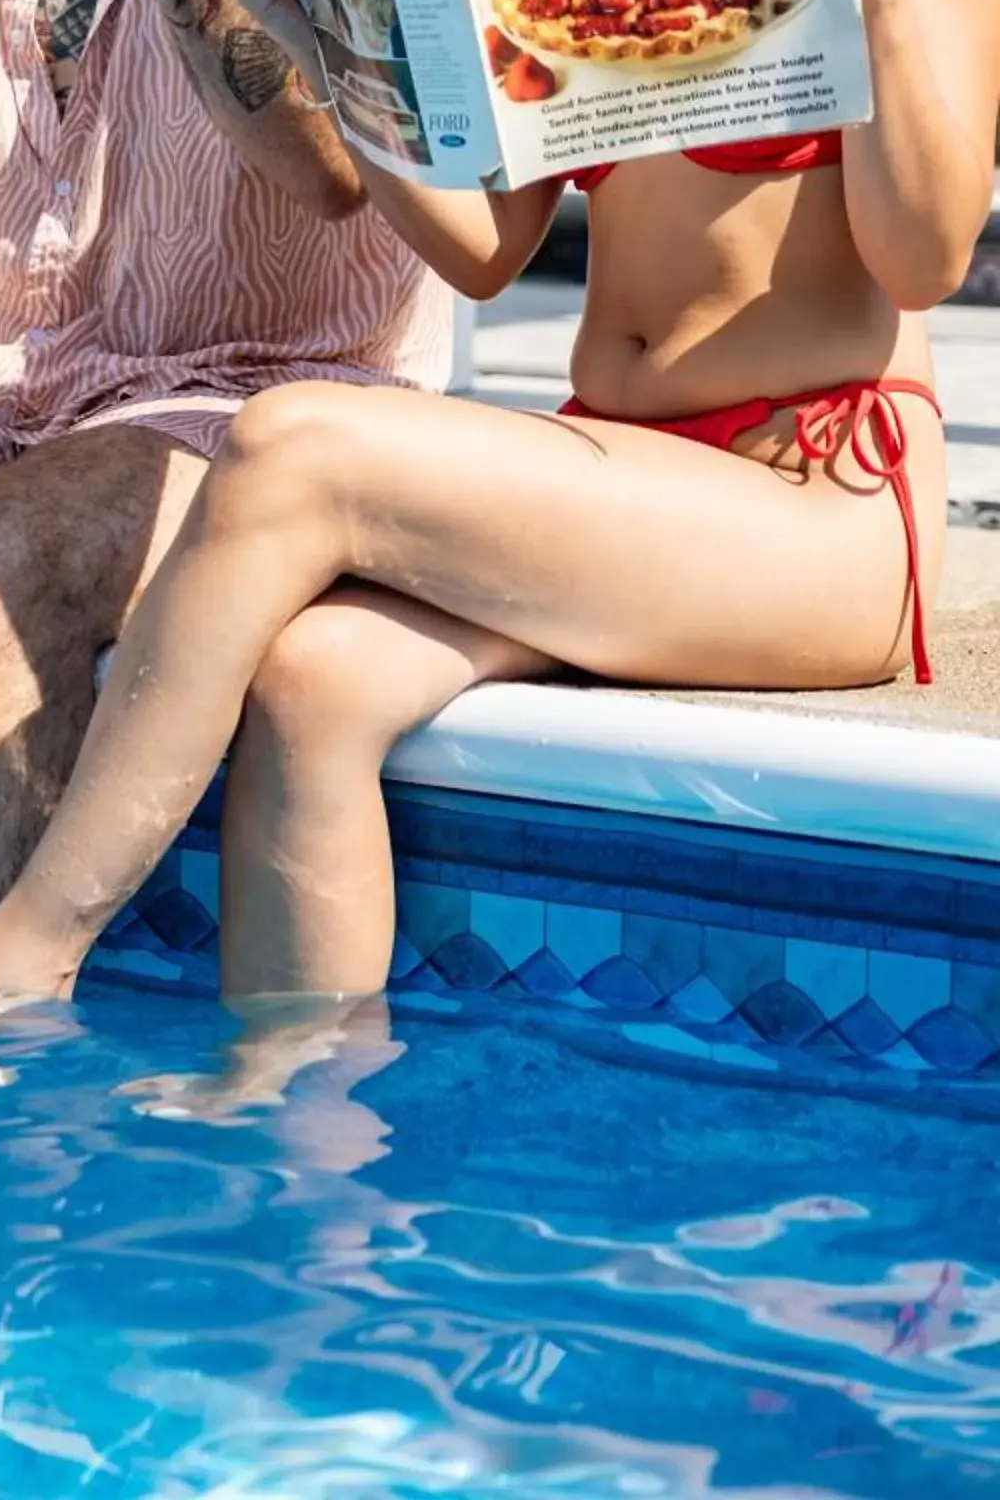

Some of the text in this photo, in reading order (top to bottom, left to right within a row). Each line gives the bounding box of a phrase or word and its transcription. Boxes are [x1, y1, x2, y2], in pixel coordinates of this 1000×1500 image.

[541, 52, 825, 115] Good furniture that won't scuttle your budget
[549, 70, 824, 129] Terrific family car vacations for this summer
[428, 112, 471, 132] FORD
[542, 86, 835, 147] Solved: landscaping problems every house has
[608, 140, 617, 148] a
[619, 129, 653, 145] small
[655, 117, 727, 140] investment
